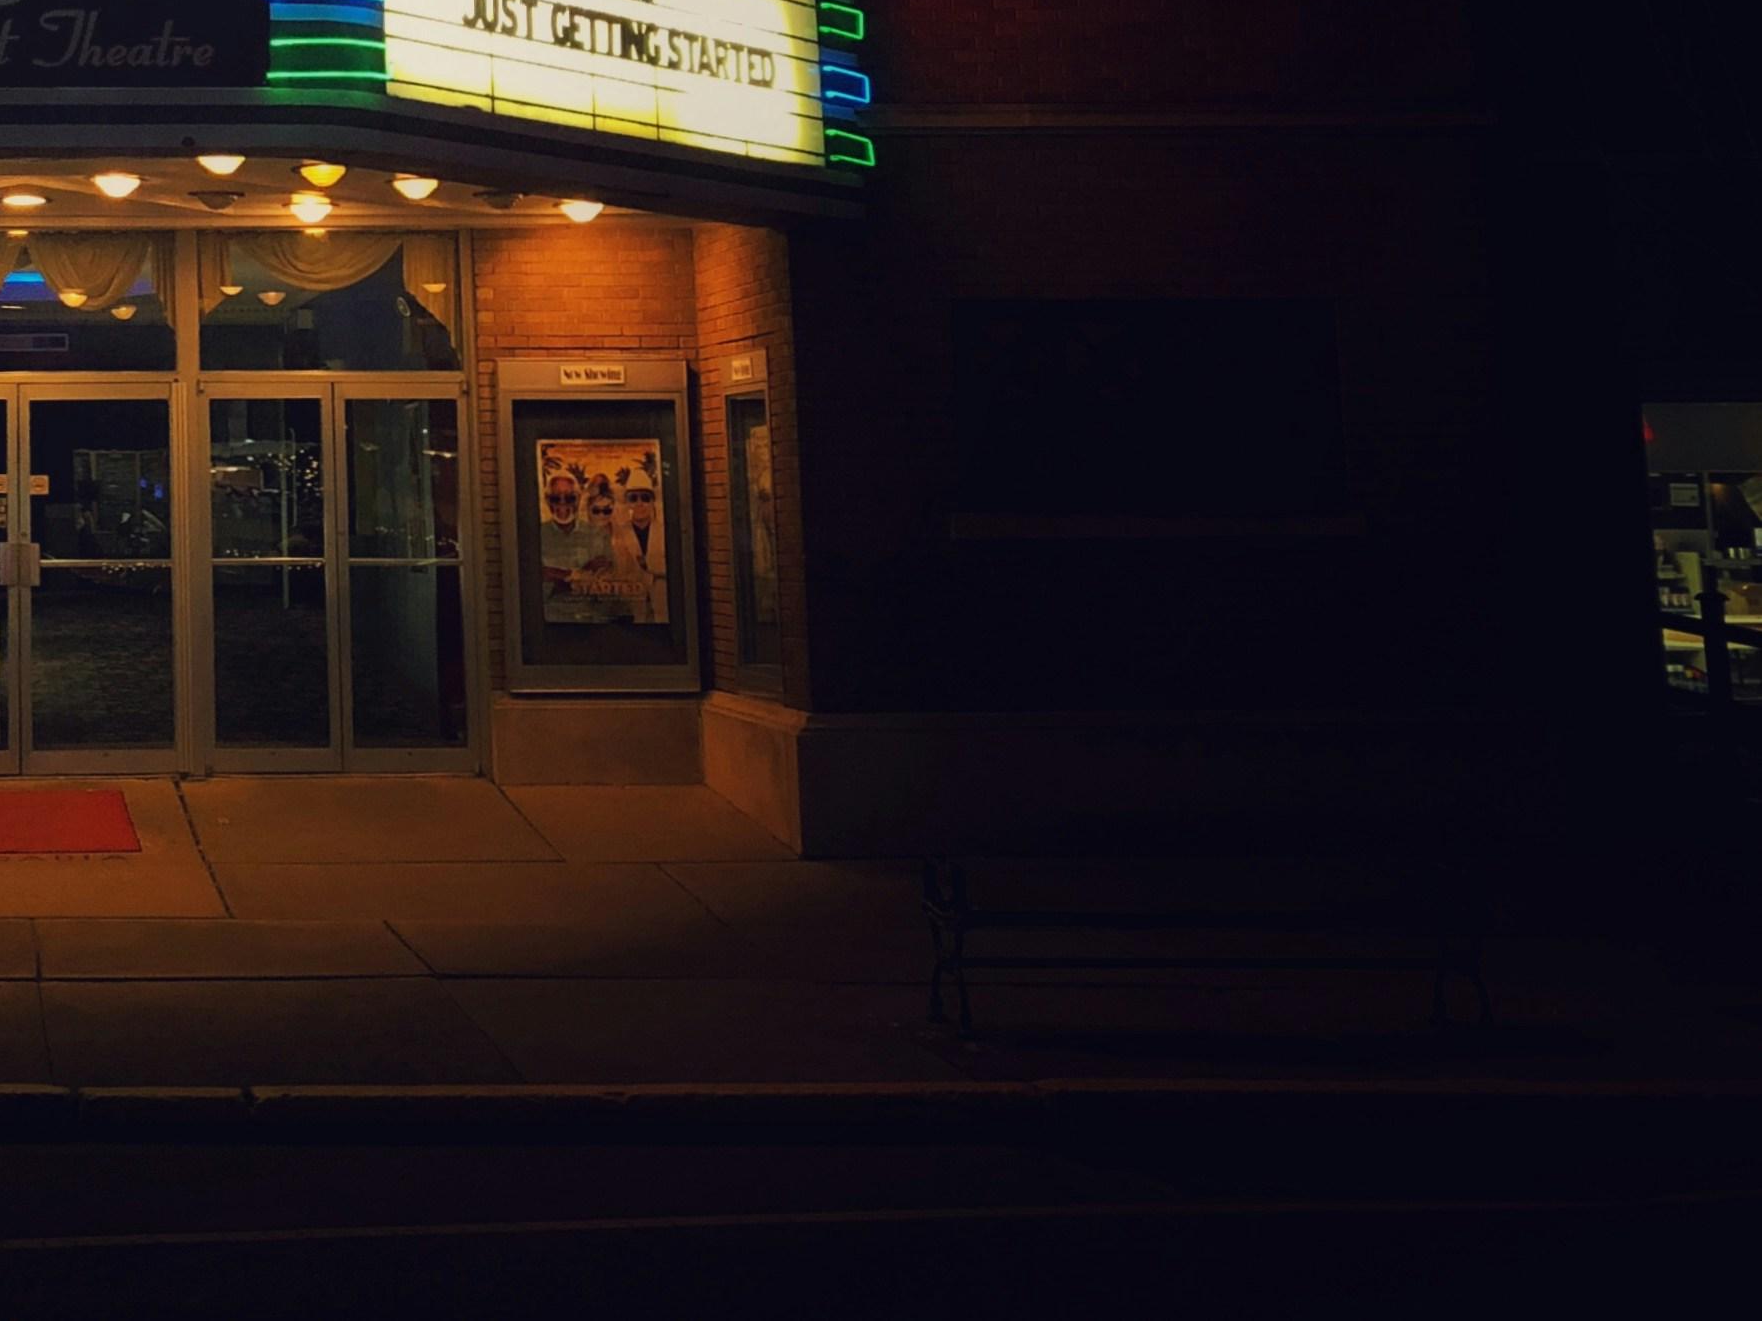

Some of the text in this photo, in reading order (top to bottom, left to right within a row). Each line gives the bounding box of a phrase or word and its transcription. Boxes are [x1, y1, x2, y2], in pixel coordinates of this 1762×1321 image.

[33, 8, 215, 67] Theatre
[551, 2, 660, 66] GETTING
[668, 28, 775, 88] STARTED
